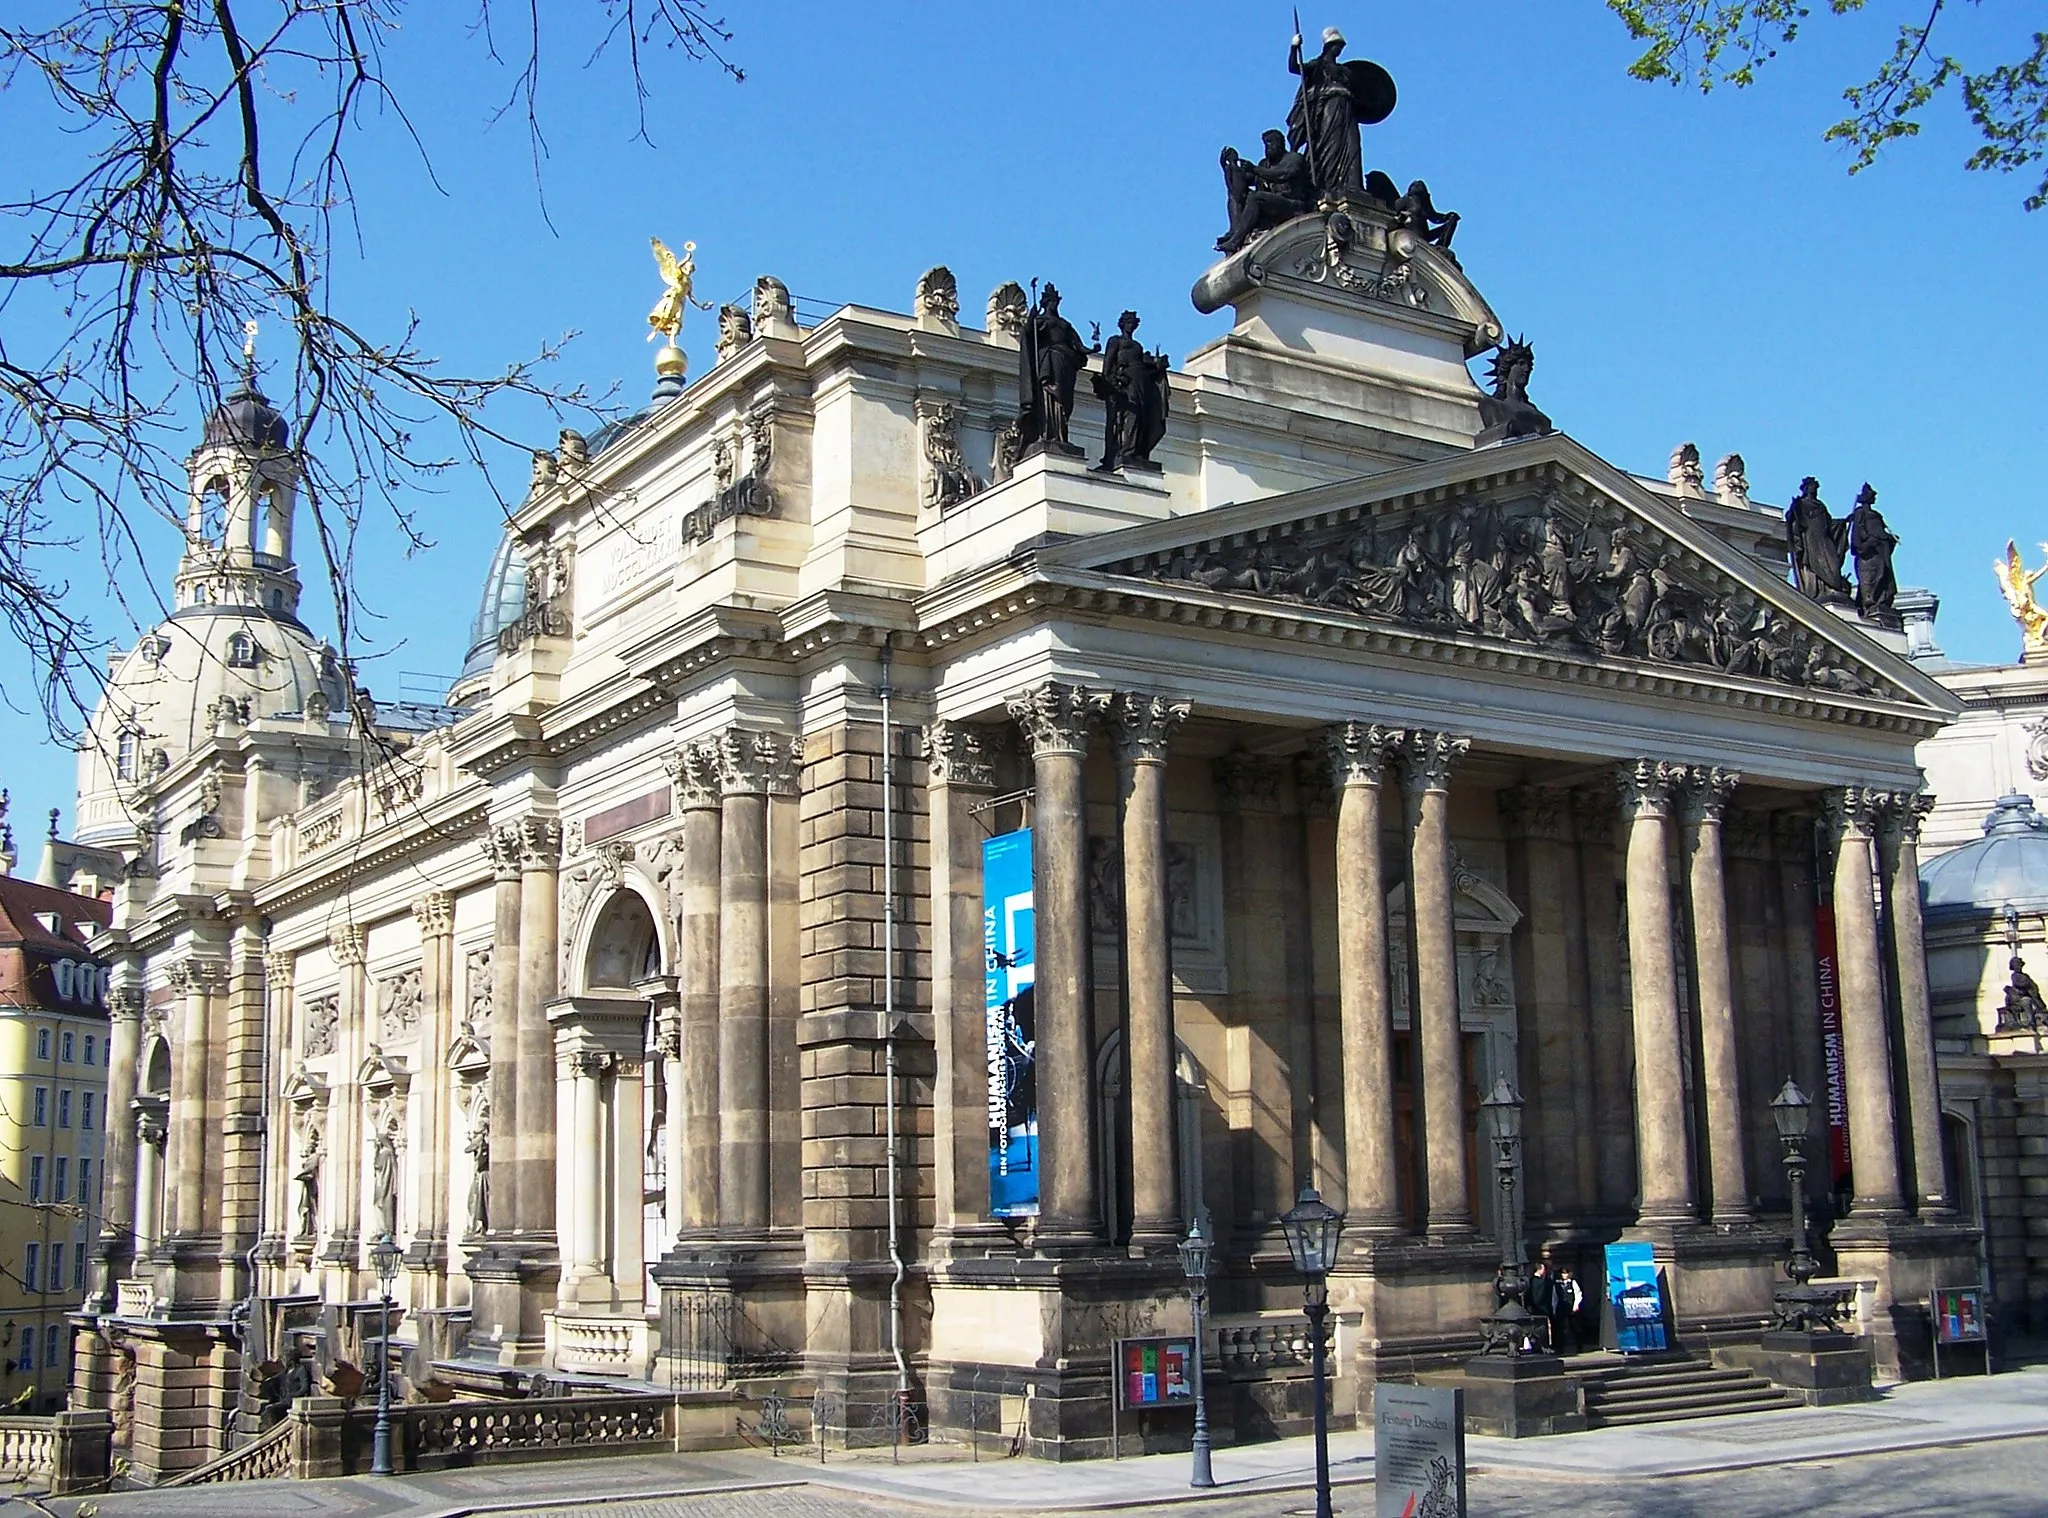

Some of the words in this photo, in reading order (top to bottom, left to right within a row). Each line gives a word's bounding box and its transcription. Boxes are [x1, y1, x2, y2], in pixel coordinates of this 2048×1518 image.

[984, 905, 998, 973] CHINA
[986, 978, 998, 1001] IN
[1818, 956, 1834, 1008] CHINA
[1823, 1012, 1836, 1028] IN
[987, 1005, 1001, 1128] HUMANISM
[1824, 1033, 1842, 1126] HUMANISM
[1000, 1156, 1008, 1176] EIN
[1414, 1414, 1449, 1430] Dresden
